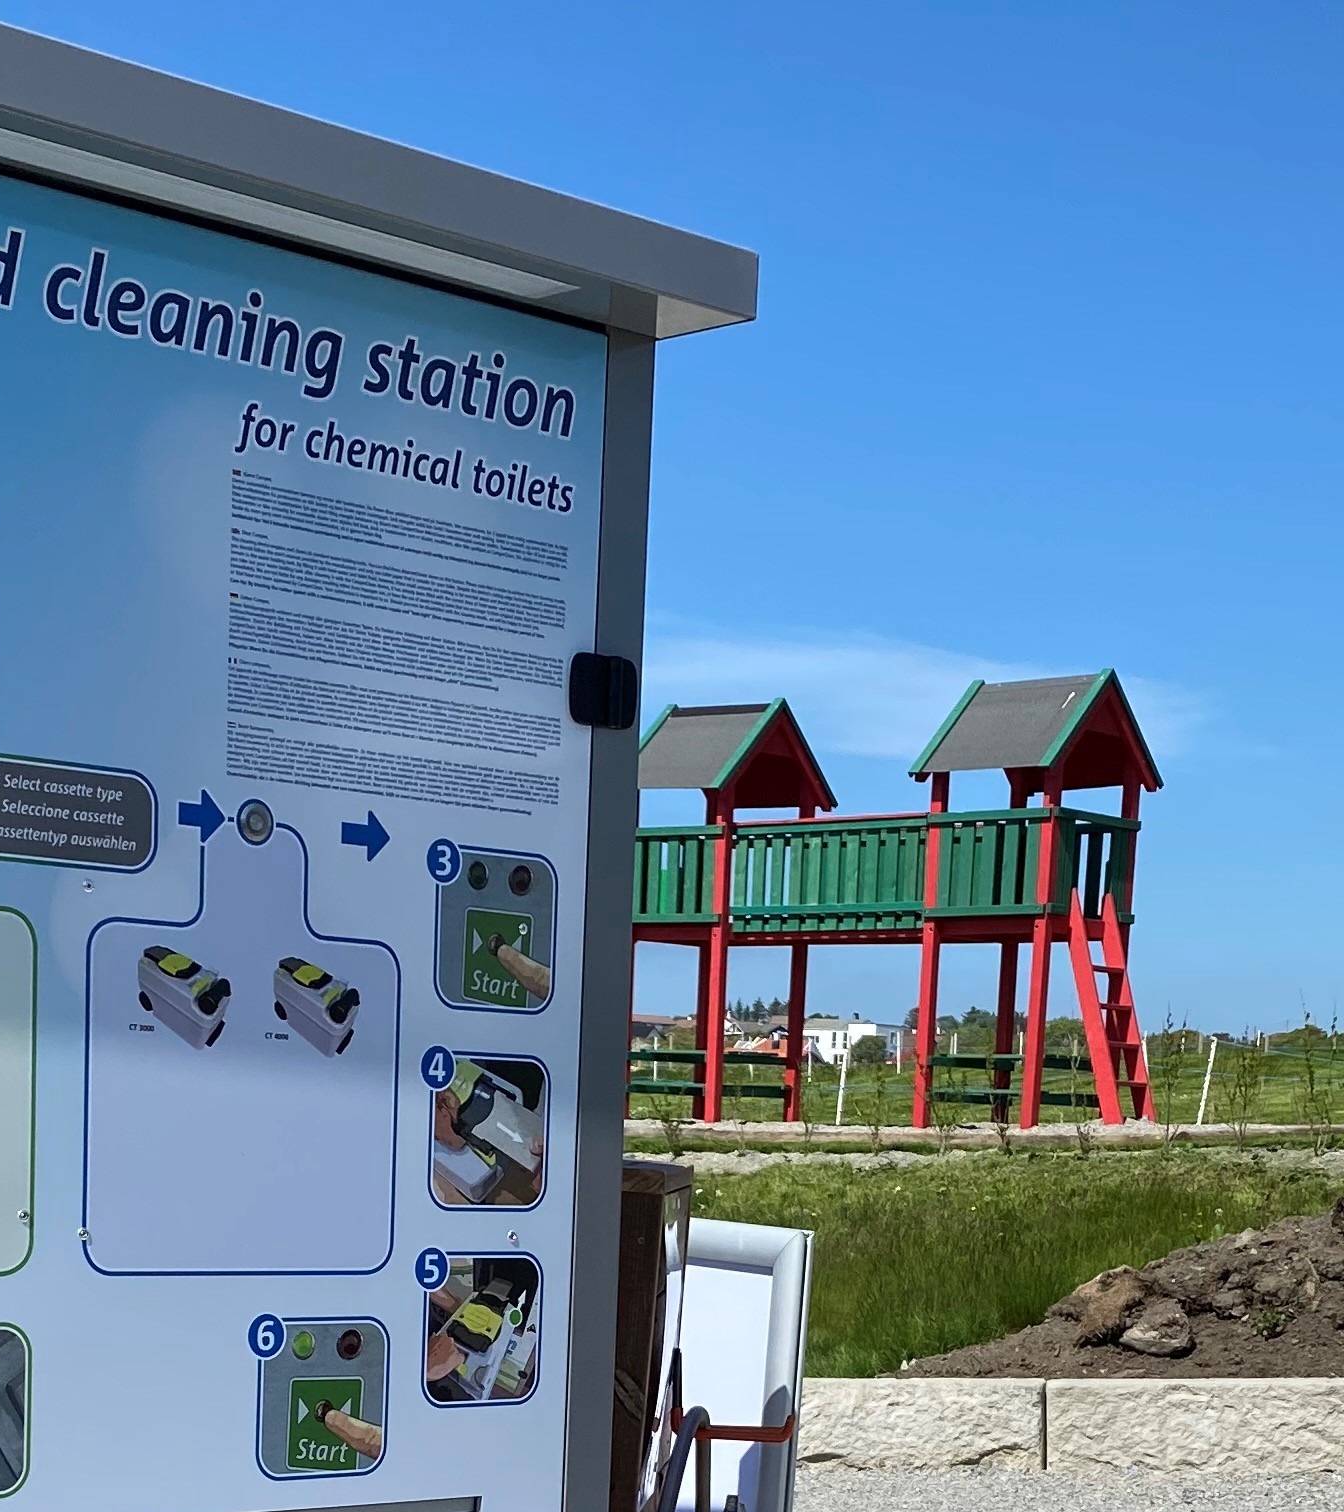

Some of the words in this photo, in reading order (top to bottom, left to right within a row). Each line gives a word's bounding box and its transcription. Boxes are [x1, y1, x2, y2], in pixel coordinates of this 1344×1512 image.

[43, 249, 346, 398] cleaning
[362, 336, 576, 439] station
[233, 403, 296, 454] for
[304, 418, 463, 490] chemical
[471, 459, 575, 513] toilets
[3, 774, 41, 792] Select
[43, 781, 94, 799] cassette
[97, 785, 123, 804] type
[1, 799, 69, 820] Seleccione
[73, 809, 125, 827] cassette
[71, 833, 137, 851] auswählen
[435, 844, 453, 877] 3
[470, 970, 520, 1001] Start
[428, 1053, 446, 1083] 4
[424, 1254, 440, 1284] 5
[257, 1320, 275, 1351] 6
[296, 1437, 348, 1464] Start
